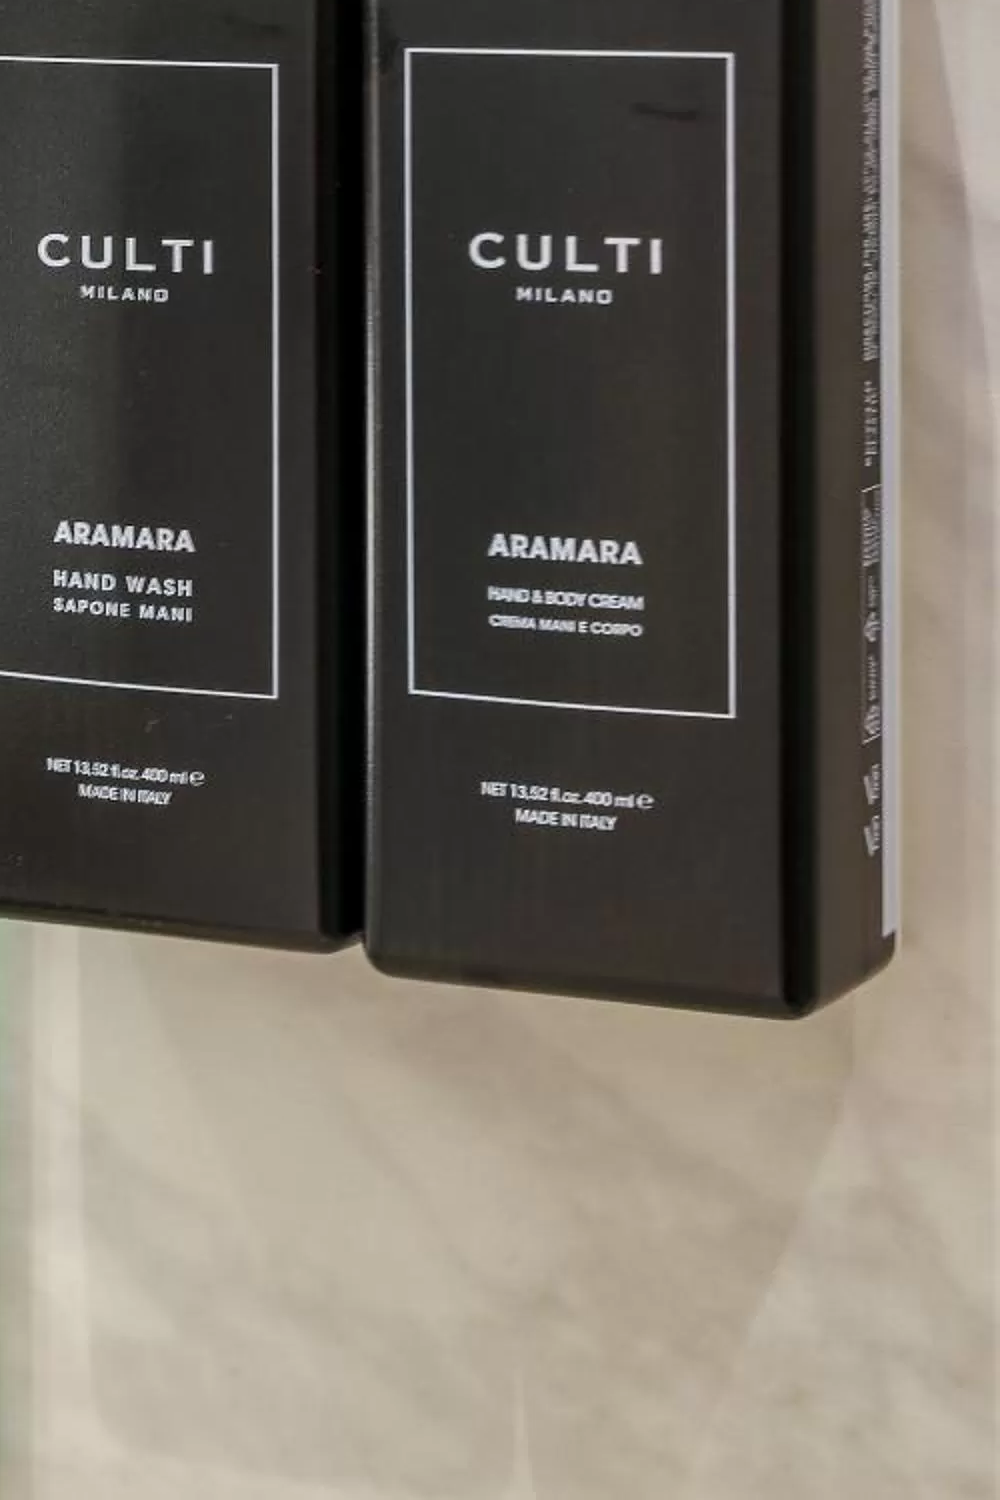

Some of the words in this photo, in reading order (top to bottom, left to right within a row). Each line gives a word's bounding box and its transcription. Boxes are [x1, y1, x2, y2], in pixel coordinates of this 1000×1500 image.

[37, 233, 213, 275] CULTI
[468, 232, 664, 275] CULTI
[80, 284, 169, 302] MILANO
[515, 286, 613, 304] MILANO
[53, 519, 197, 553] ARAMARA
[487, 533, 644, 565] ARAMARA
[53, 569, 117, 592] HAND
[125, 575, 193, 597] WASH
[53, 597, 132, 617] SAPONE
[139, 604, 193, 622] MANI
[487, 586, 530, 603] HAND
[544, 591, 587, 607] BODY
[587, 593, 645, 610] CREAM
[488, 614, 536, 630] CREMA
[577, 620, 589, 633] E
[589, 621, 643, 637] CORPO
[78, 784, 118, 801] MADE
[137, 789, 172, 805] ITALY
[480, 781, 508, 797] NET
[514, 808, 560, 826] MADE
[561, 812, 578, 827] IN
[579, 814, 618, 831] ITALY
